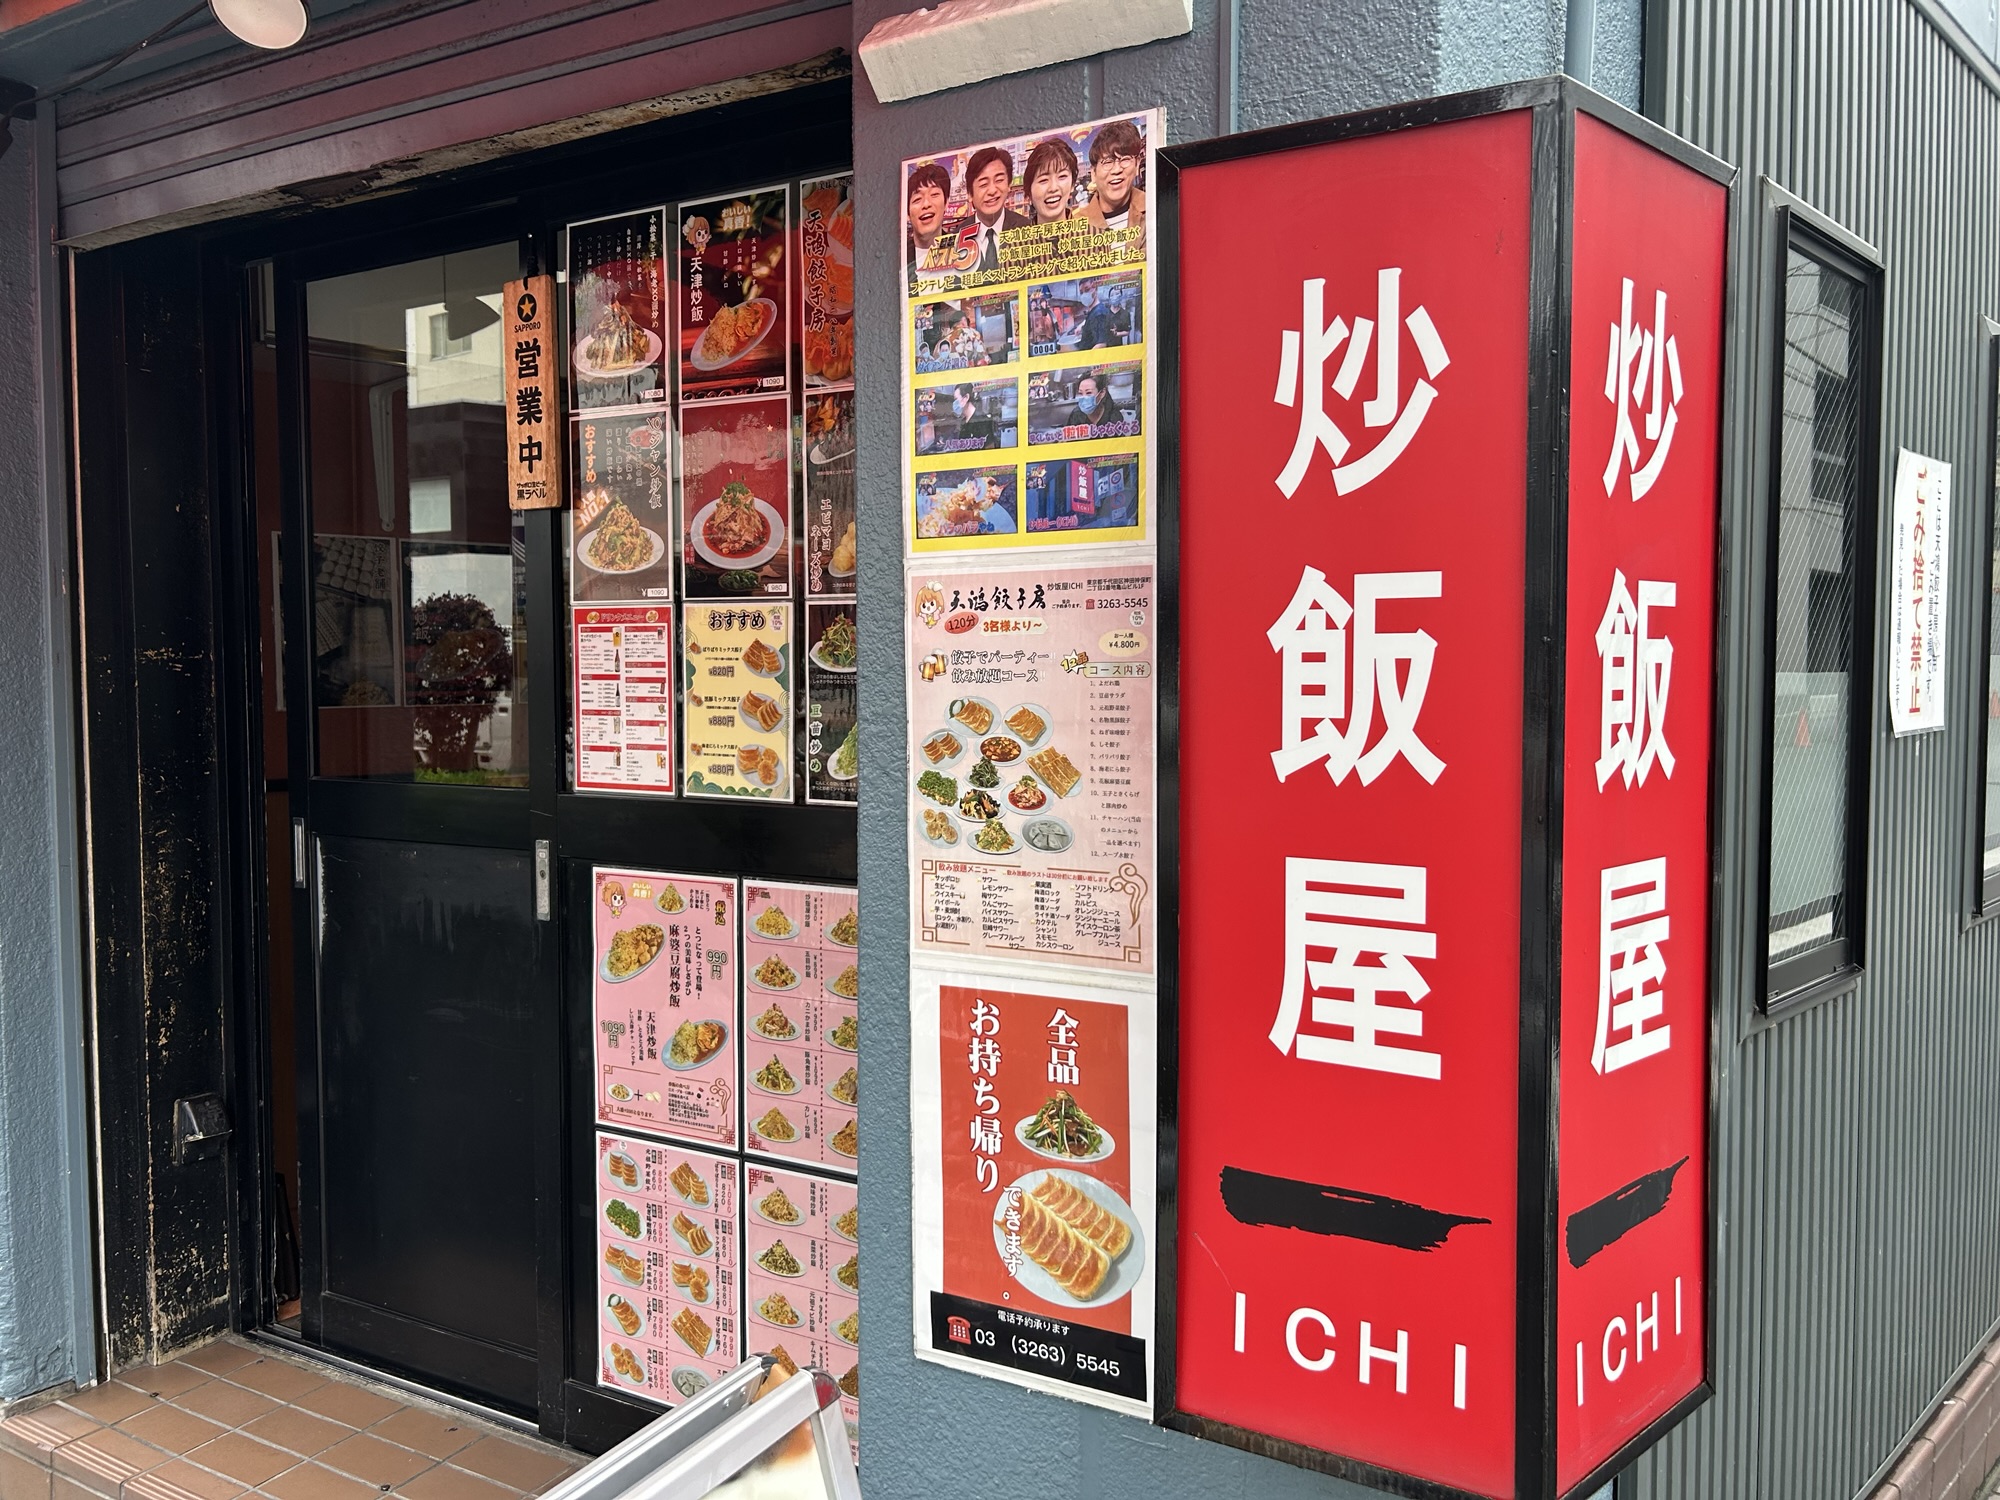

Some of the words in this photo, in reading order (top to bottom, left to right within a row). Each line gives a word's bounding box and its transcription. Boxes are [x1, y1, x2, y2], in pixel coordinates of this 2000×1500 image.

[998, 217, 1089, 245] 天鴻餃子房系列店
[953, 224, 980, 271] 5
[998, 243, 1052, 264] 炒飯屋ICHI
[1058, 225, 1142, 257] 炒飯屋の炒飯が
[909, 275, 955, 295] フジテレビ
[960, 249, 1147, 288] 超超ベストランキングで紹介されました。
[690, 257, 703, 322] 天津炒飯
[514, 322, 542, 333] SAPPORO
[515, 337, 543, 474] 営業中
[944, 436, 987, 450] 人気あります
[584, 424, 597, 484] おすすめ
[516, 487, 548, 501] 黒ラベル
[820, 498, 833, 551] エビマヨ
[1909, 465, 1928, 715] ごみ捨て禁止
[949, 584, 1047, 613] 天鴻餃子房
[1097, 597, 1149, 609] 3263-5545
[709, 610, 766, 631] おすすめ
[948, 614, 977, 631] 120分
[1061, 651, 1089, 672] 12品
[1089, 664, 1146, 676] コース内容
[1266, 267, 1450, 1080] 炒飯屋
[1591, 277, 1683, 1076] 炒飯屋
[809, 703, 823, 773] 豆苗炒め
[1101, 827, 1139, 835] のメニューから
[938, 862, 997, 874] 飲み放題メニュー
[934, 882, 956, 890] 生ビール
[981, 884, 1014, 893] レモンサワー
[1034, 881, 1052, 889] 果実酒
[1075, 884, 1115, 893] ソフトドリンク
[934, 890, 961, 898] ウイスキー
[1034, 888, 1061, 897] 梅酒ロック
[1075, 891, 1092, 899] コーラ
[934, 898, 961, 906] ハイボール
[981, 900, 1014, 908] りんごサワー
[1034, 896, 1061, 904] 梅酒ソーダ
[1034, 911, 1071, 921] ライチ酒ソーダ
[1074, 907, 1121, 917] オレンジジュース
[981, 916, 1020, 924] カルピスサワー
[1035, 918, 1057, 927] カクテル
[1074, 914, 1121, 925] ジンジャーエール
[1074, 922, 1121, 933] アイスウーロン茶
[1075, 929, 1121, 940] グレープフルーツ
[982, 932, 1025, 942] グレープフルーツ
[1098, 940, 1121, 948] ジュース
[1035, 941, 1075, 951] カシスウーロン
[706, 949, 728, 965] 990
[669, 924, 681, 1008] 麻婆豆腐炒飯
[711, 964, 723, 980] 円
[646, 1011, 657, 1060] 天津炒飯
[1046, 1007, 1080, 1086] 全品
[968, 998, 1004, 1194] お持ち帰り
[1002, 1185, 1023, 1300] できます。
[1575, 1276, 1682, 1407] ICHI
[974, 1328, 996, 1347] 03
[1011, 1335, 1067, 1366] (3263)
[1076, 1353, 1121, 1378] 5545
[1234, 1291, 1467, 1410] ICHI
